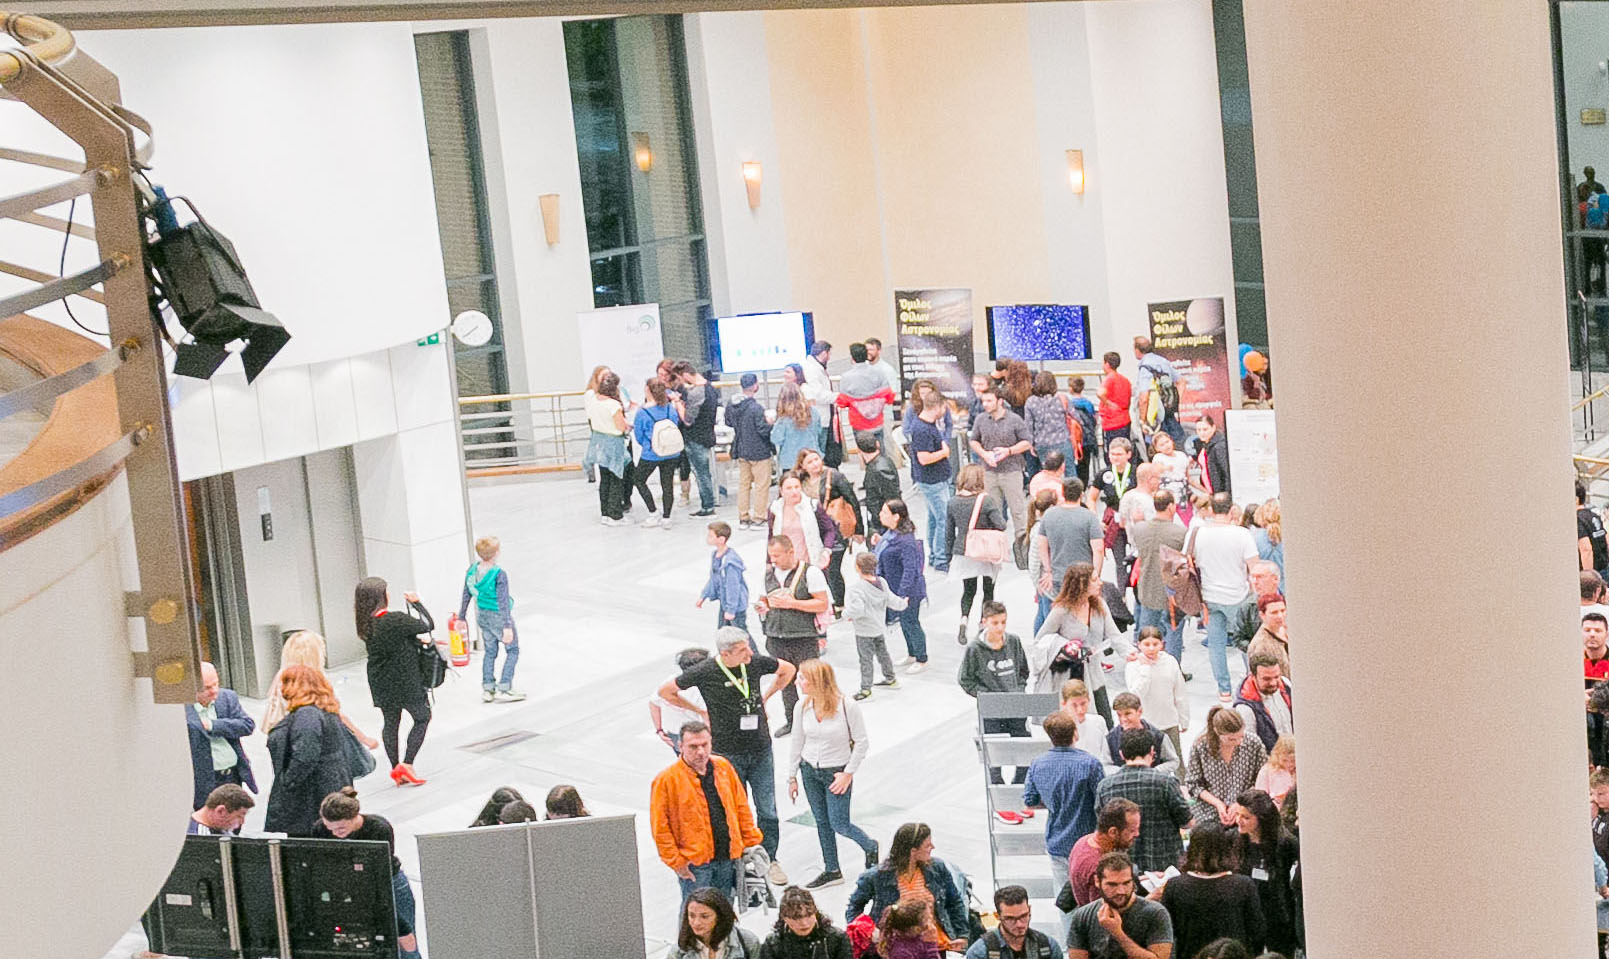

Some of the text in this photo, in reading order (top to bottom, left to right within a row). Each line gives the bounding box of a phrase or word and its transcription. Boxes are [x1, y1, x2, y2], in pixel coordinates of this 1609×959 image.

[1152, 310, 1185, 324] Όμιλος
[1153, 323, 1184, 336] Φίλων
[1154, 334, 1214, 350] Αστρονομίας
